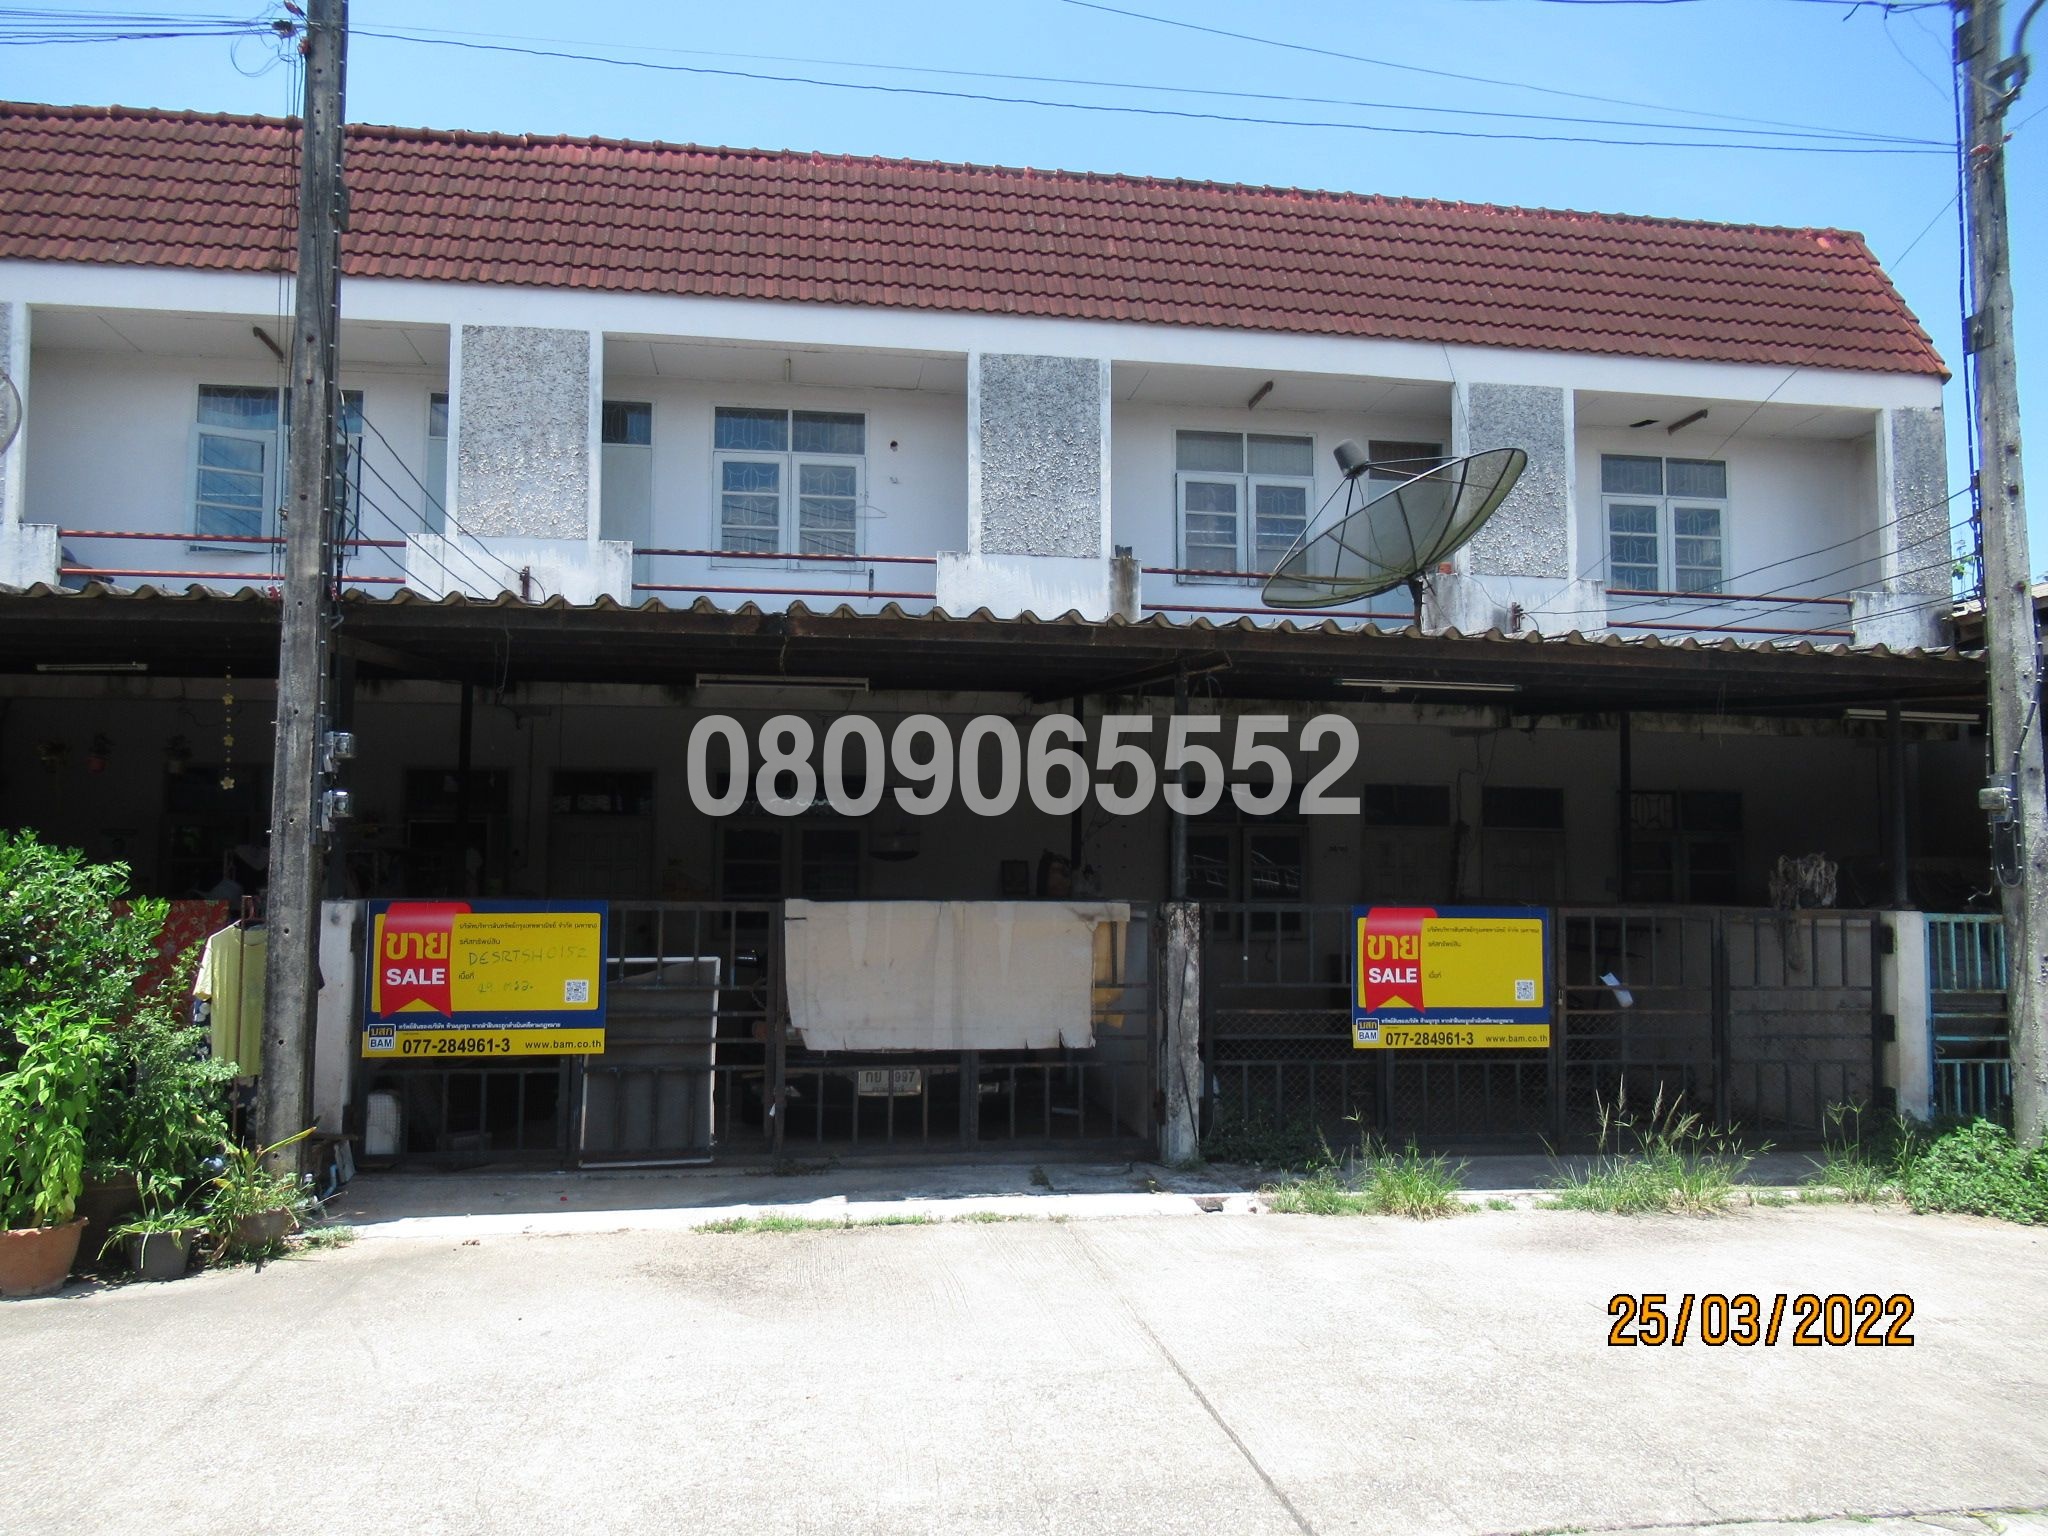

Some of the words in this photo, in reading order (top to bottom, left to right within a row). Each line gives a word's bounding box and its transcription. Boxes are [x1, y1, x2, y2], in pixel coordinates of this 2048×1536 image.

[386, 932, 448, 960] ขาย
[1367, 935, 1419, 960] ขาย
[386, 968, 445, 985] SALE
[1368, 967, 1418, 984] SALE
[370, 1039, 393, 1048] BAM
[1358, 1031, 1377, 1040] BAM
[1385, 1031, 1474, 1046] 077-284961-3
[1485, 1032, 1548, 1043] www.bam.co.th
[402, 1037, 511, 1055] 077-284961-3
[525, 1038, 602, 1050] www.bam.co.th
